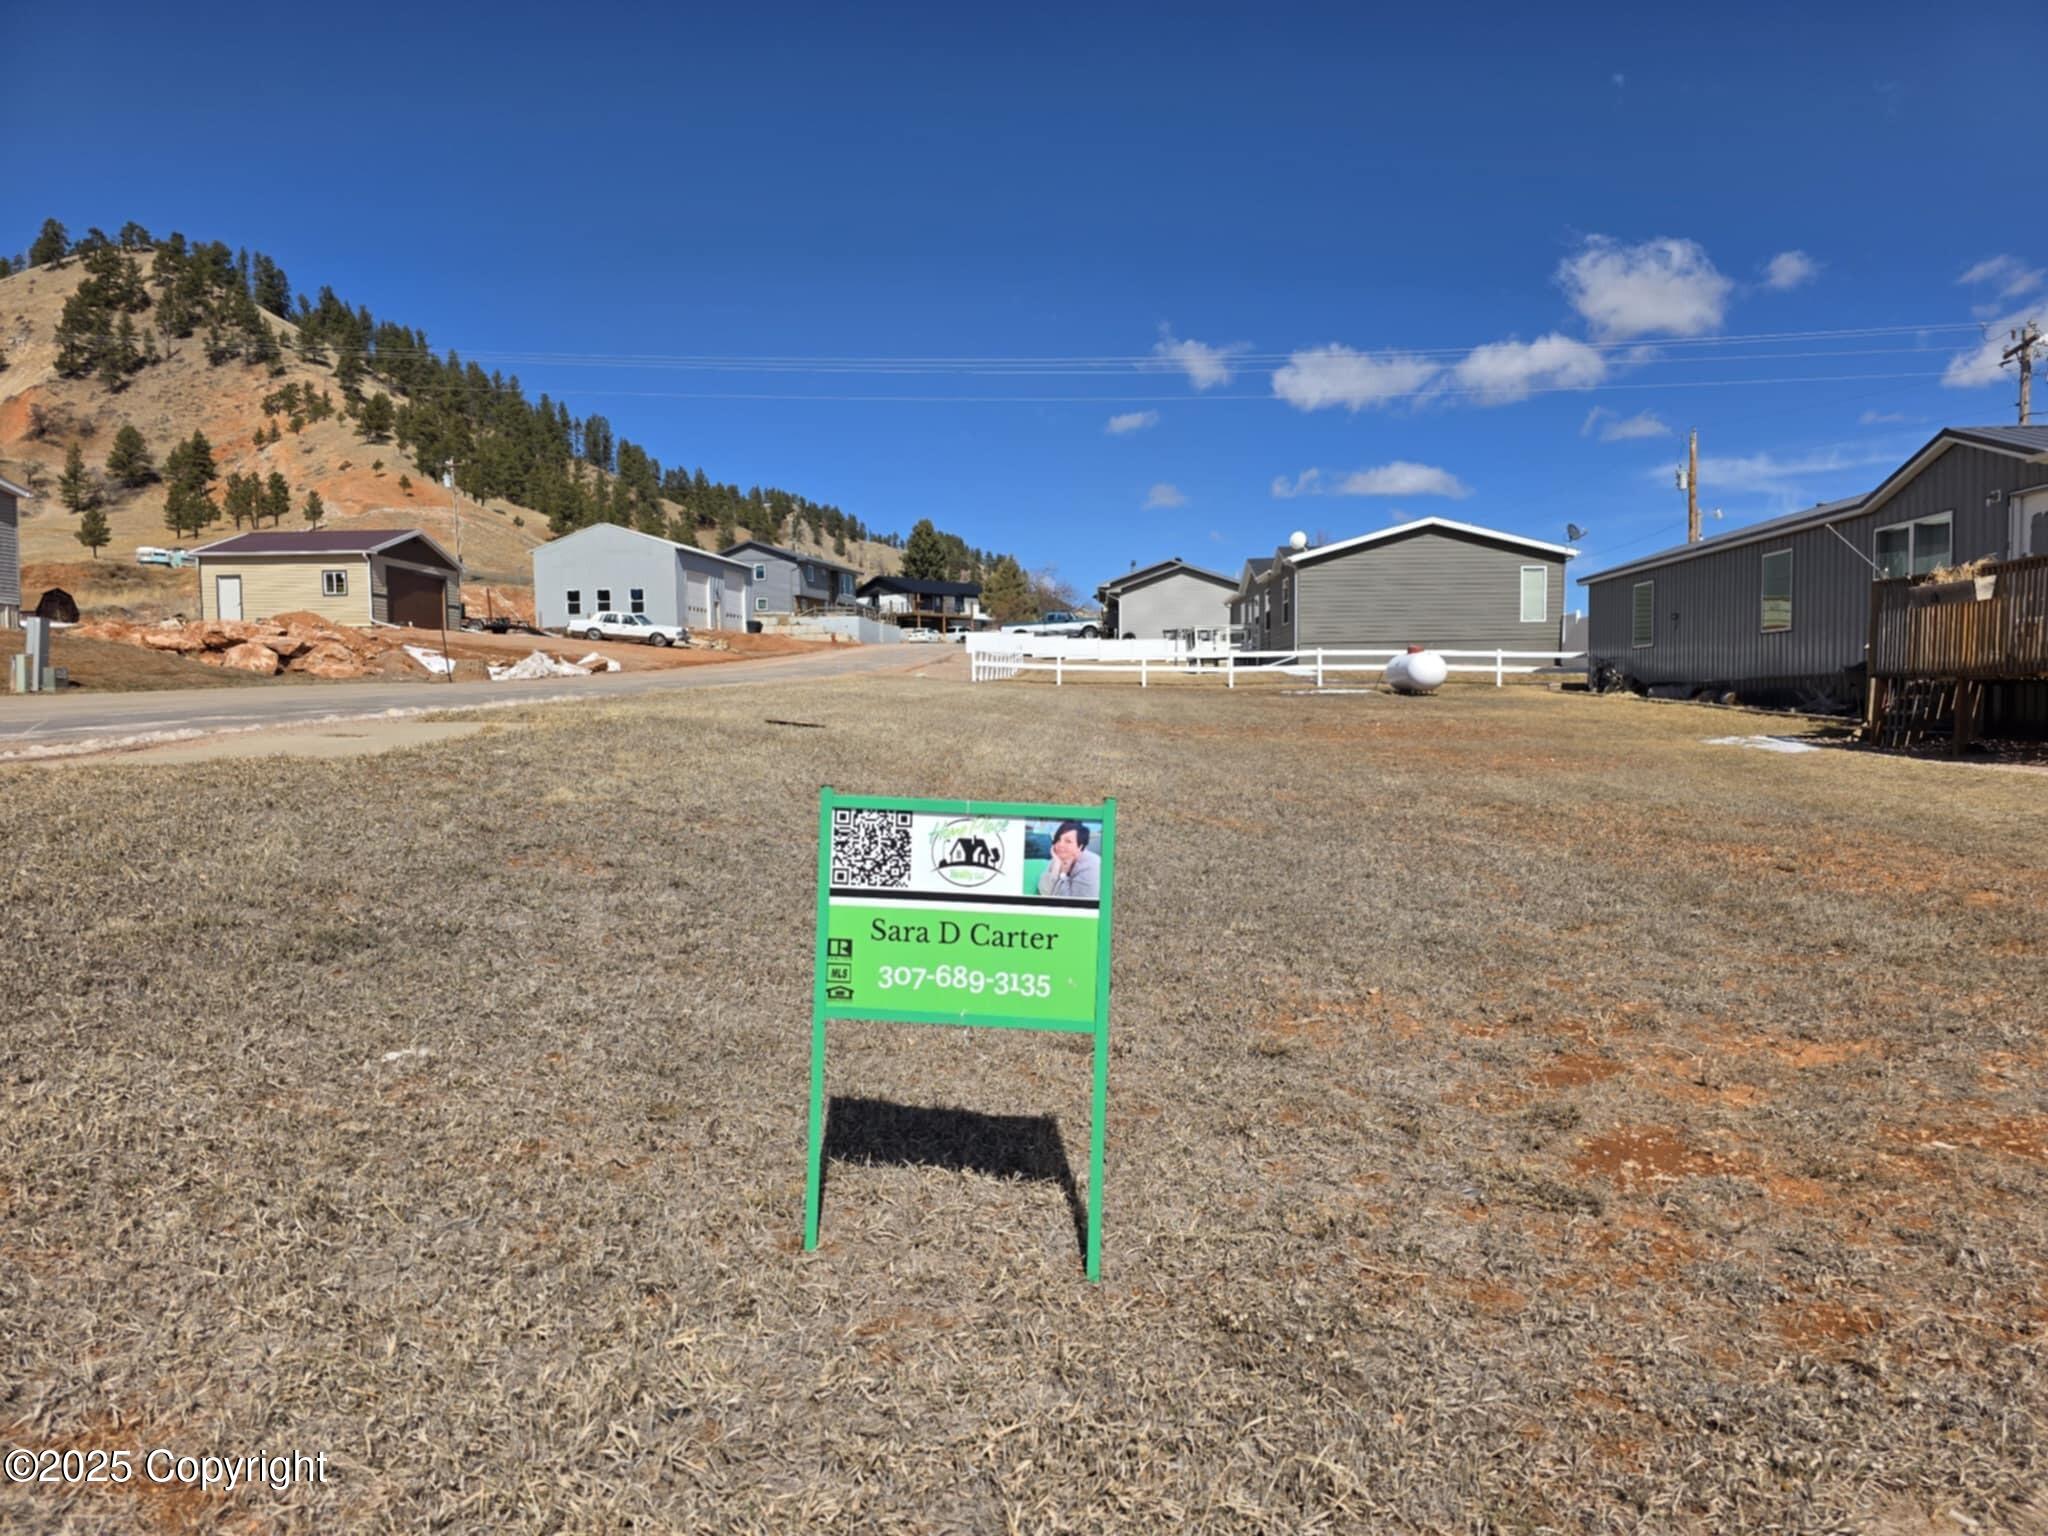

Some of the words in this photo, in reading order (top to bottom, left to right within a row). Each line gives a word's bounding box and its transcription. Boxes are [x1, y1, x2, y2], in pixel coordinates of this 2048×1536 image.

[871, 918, 930, 943] Sara
[938, 921, 961, 944] D
[970, 923, 1059, 950] Carter
[831, 968, 848, 979] MLS
[878, 965, 1051, 997] 307-689-3135
